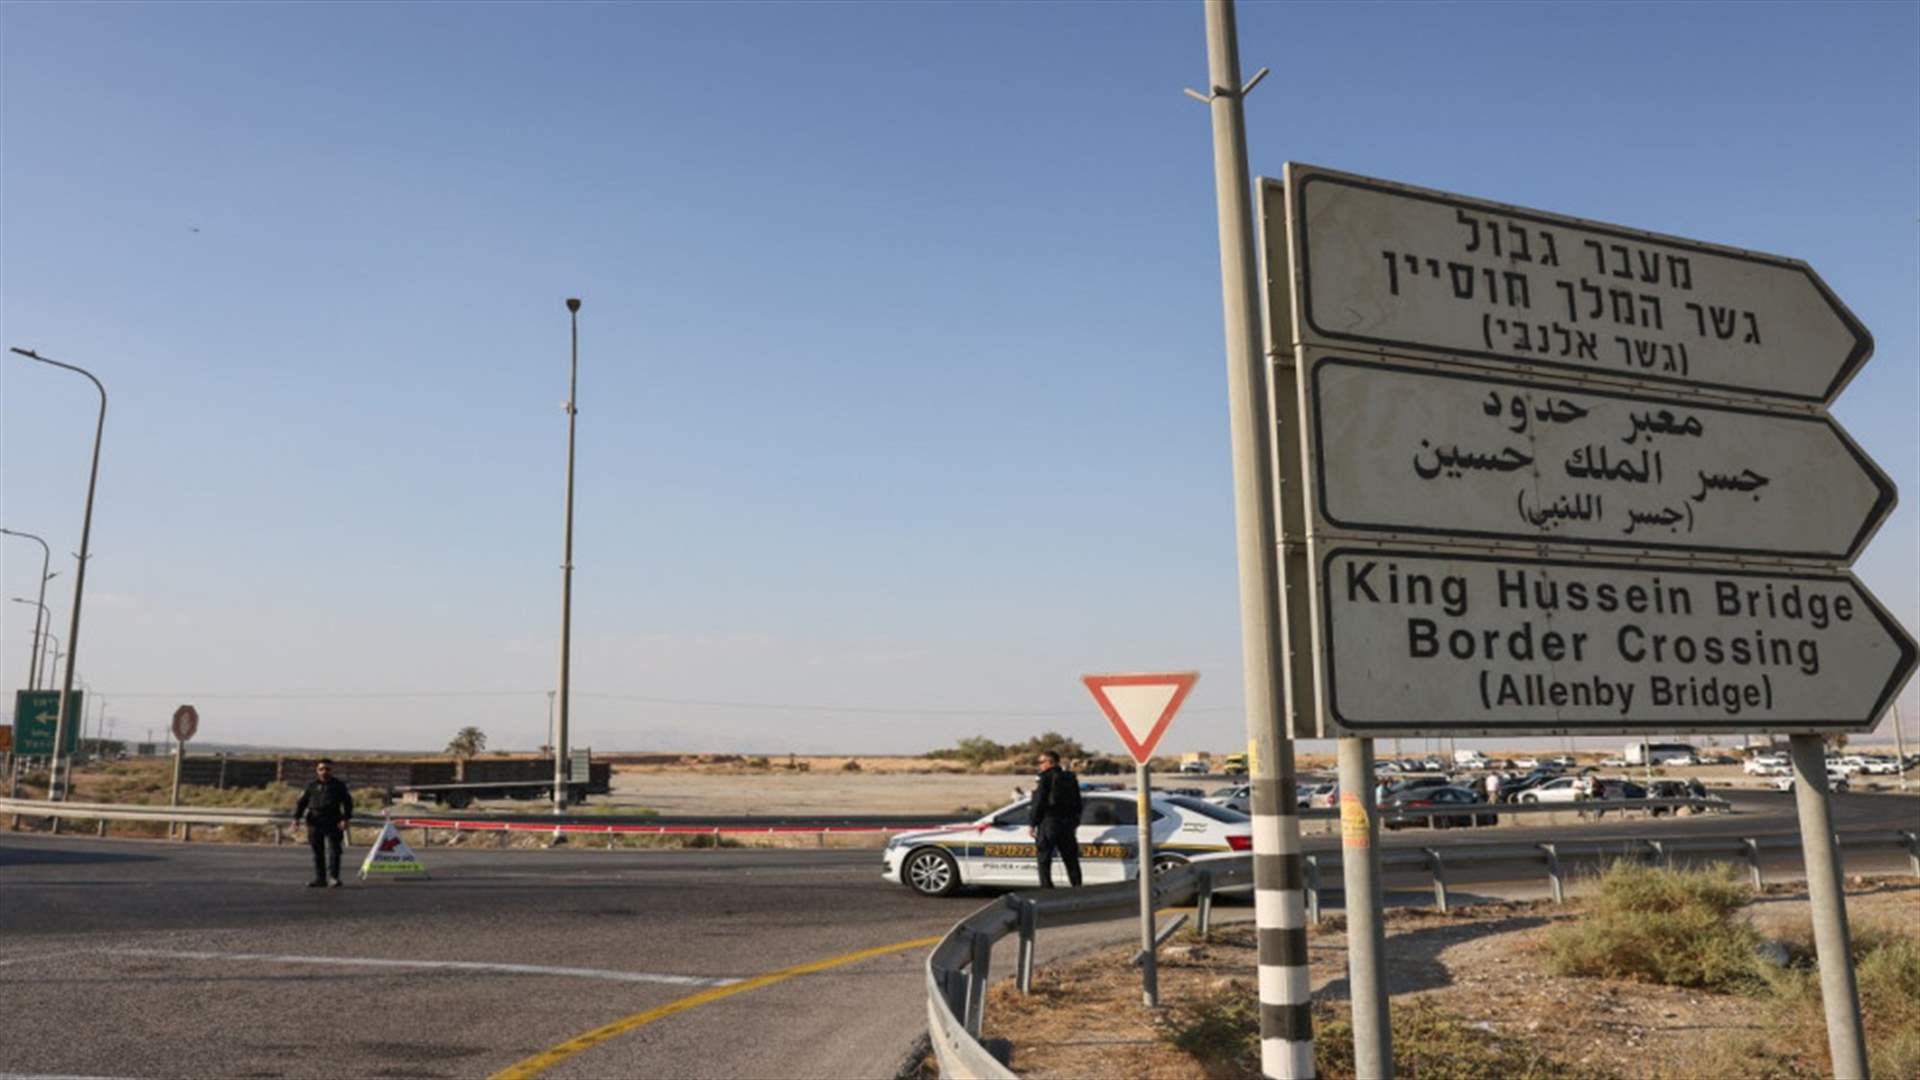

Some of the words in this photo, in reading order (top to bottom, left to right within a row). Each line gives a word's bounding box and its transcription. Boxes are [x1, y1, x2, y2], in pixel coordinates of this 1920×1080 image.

[1456, 209, 1561, 268] גבול
[1380, 250, 1534, 309] חוסיין
[1583, 238, 1694, 292] מעבר
[1555, 277, 1664, 331] המלך
[1684, 301, 1763, 347] גשר
[1482, 313, 1599, 361] אלנבי)
[1613, 334, 1690, 377] (גשר
[1482, 392, 1590, 435] حدود
[1621, 410, 1705, 446] معبر
[1412, 437, 1534, 480] حسين
[1564, 443, 1664, 486] الملك
[1690, 467, 1772, 504] جسر
[1622, 499, 1695, 534] (جسر
[1345, 560, 1469, 618] King
[1496, 567, 1694, 617] Hussein
[1714, 579, 1854, 629] Bridge
[1407, 617, 1589, 664] Border
[1616, 623, 1821, 677] Crossing
[1479, 669, 1637, 714] (Allenby
[1650, 674, 1774, 713] Bridge)
